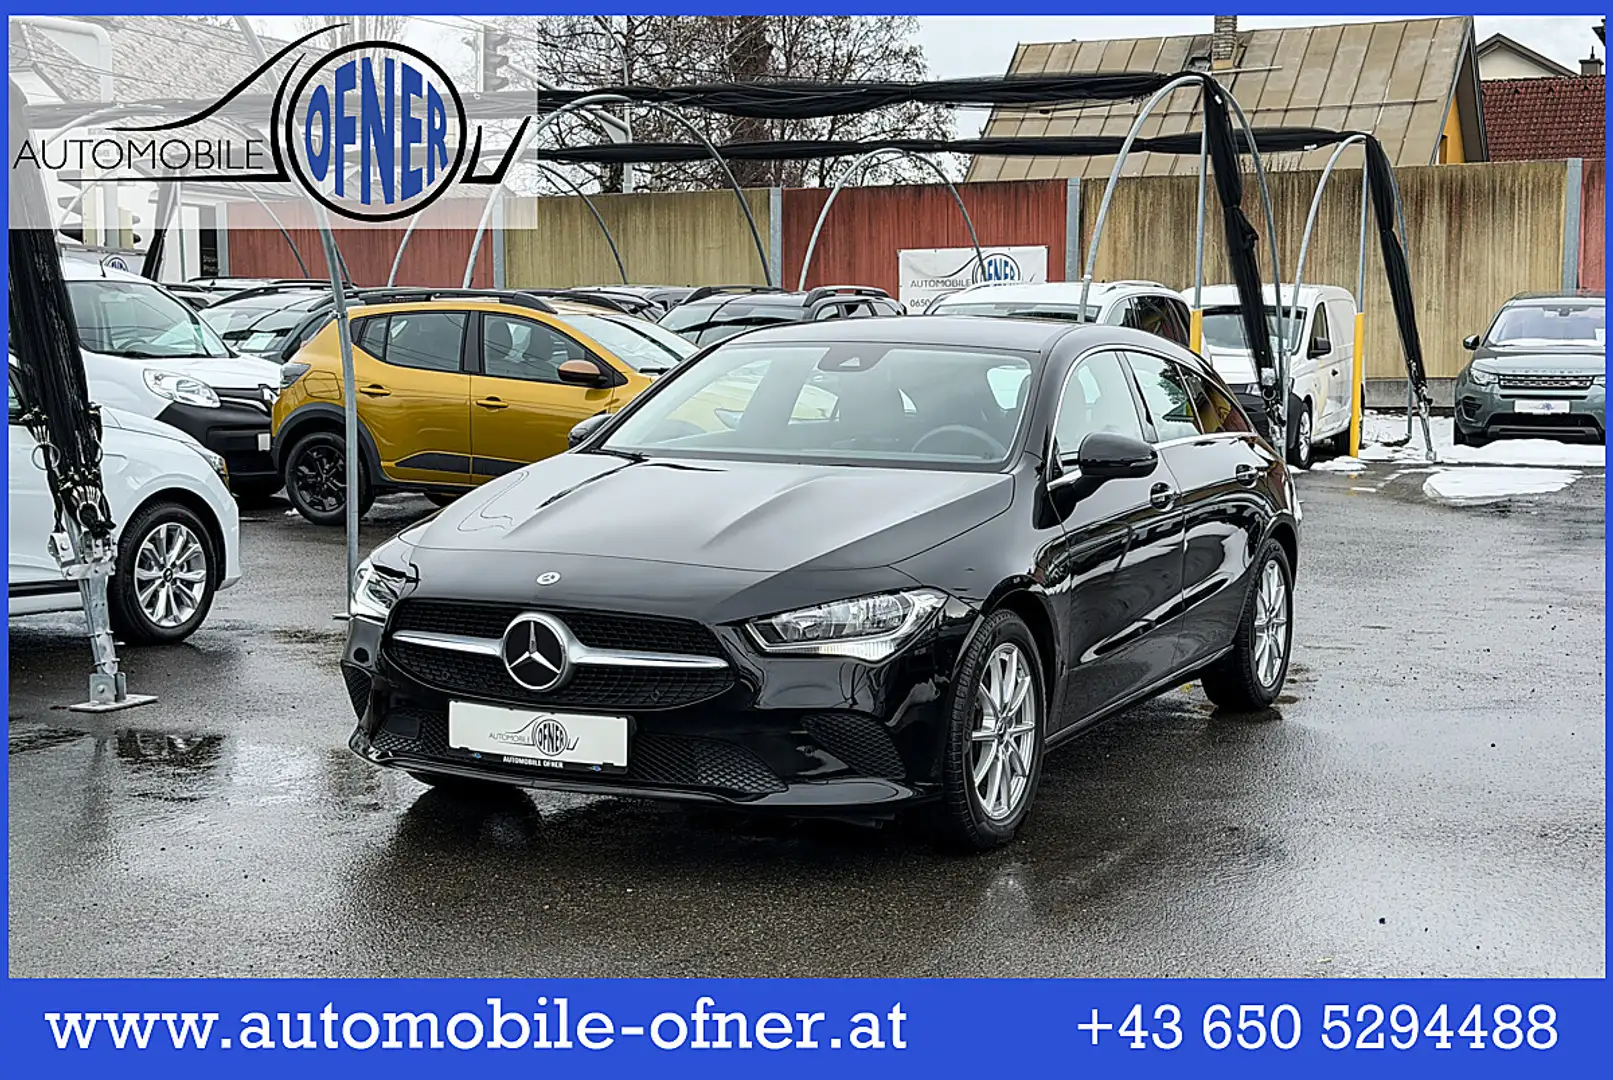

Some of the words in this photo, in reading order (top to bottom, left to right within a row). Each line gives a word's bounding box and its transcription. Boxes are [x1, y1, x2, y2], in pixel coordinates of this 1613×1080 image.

[910, 278, 971, 288] AUTOMOBILE
[538, 722, 565, 753] OFNER
[503, 756, 541, 767] AUTOMOBILE
